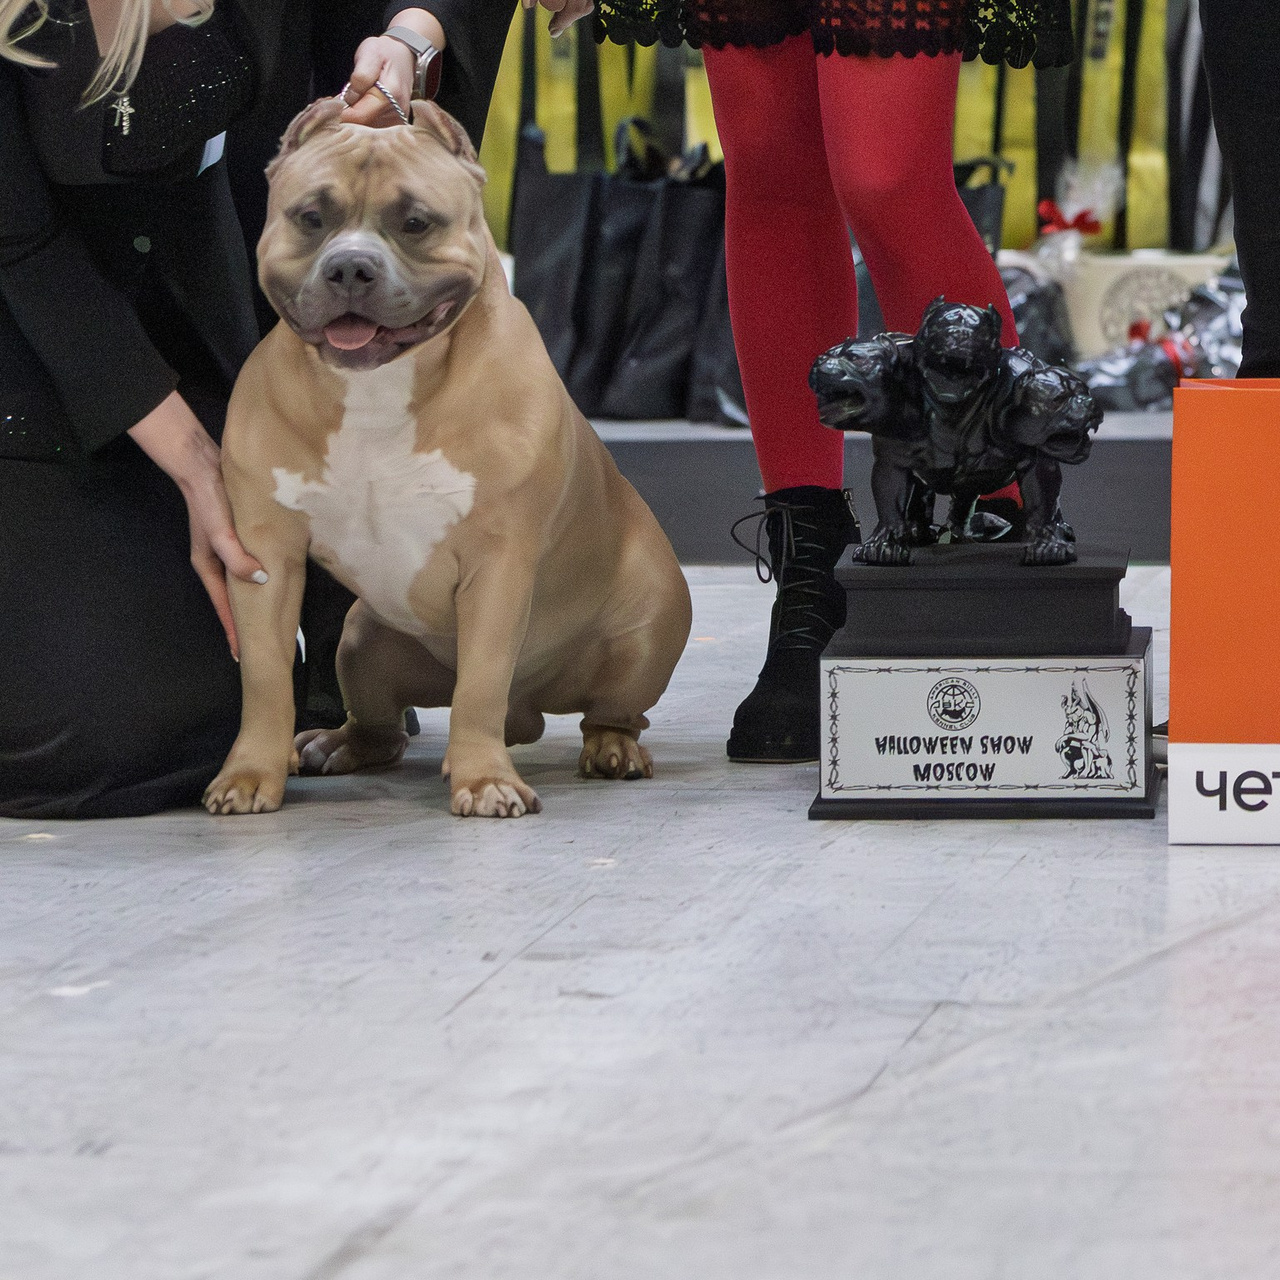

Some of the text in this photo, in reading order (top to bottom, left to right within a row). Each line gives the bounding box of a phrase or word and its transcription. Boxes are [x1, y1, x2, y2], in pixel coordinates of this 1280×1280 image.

[874, 735, 1034, 755] HALLOWEEN SHOW
[913, 762, 996, 782] MOSCOW
